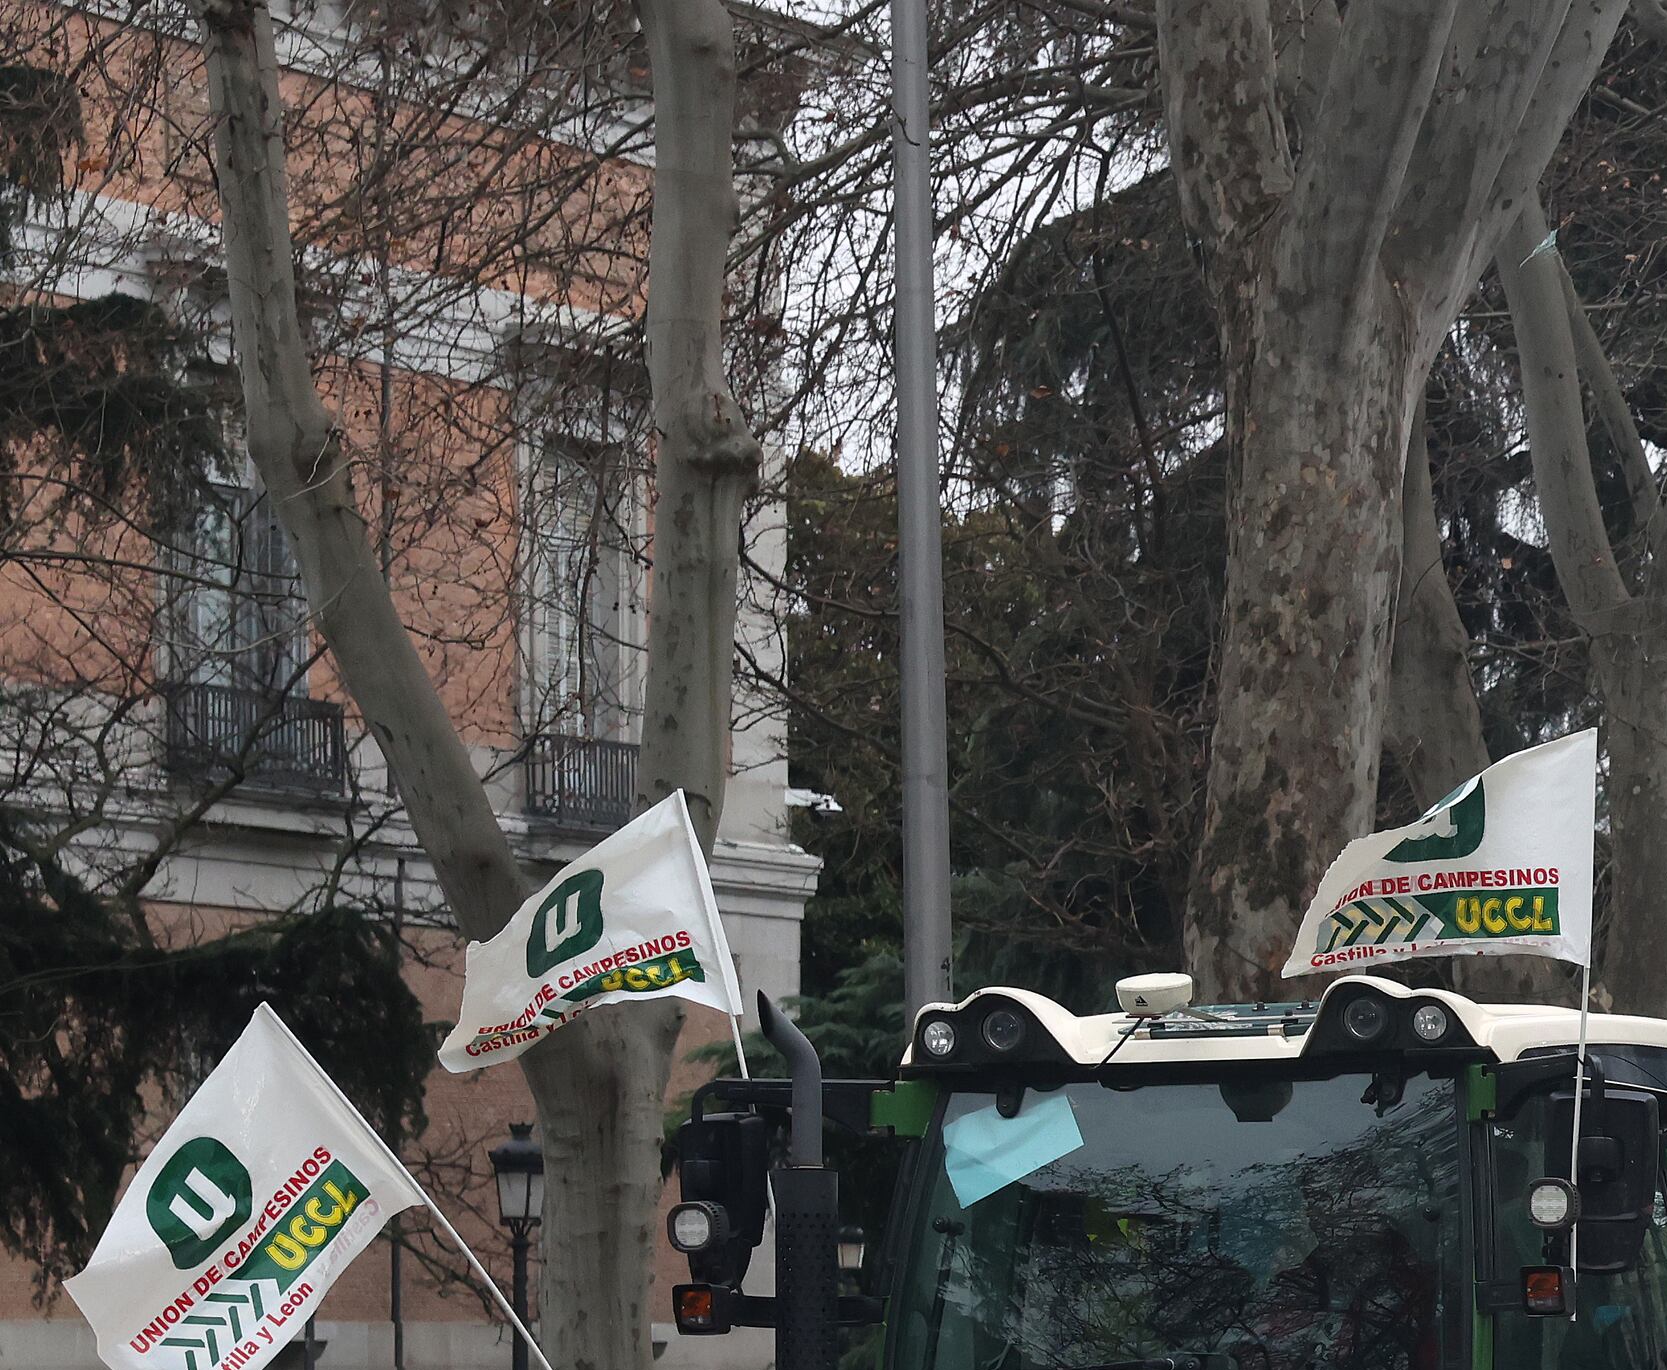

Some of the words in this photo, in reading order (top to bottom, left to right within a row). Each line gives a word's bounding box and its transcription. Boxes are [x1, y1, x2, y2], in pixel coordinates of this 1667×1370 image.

[1381, 875, 1411, 895] DE
[1417, 867, 1560, 892] CAMPESINOS
[1455, 896, 1553, 934] UCCL
[535, 983, 558, 1010] DE
[557, 930, 692, 989] CAMPESINOS
[129, 1292, 194, 1355] UNION
[192, 1265, 224, 1297] DE
[223, 1144, 333, 1269] CAMPESINOS
[264, 1180, 358, 1271] UCCL
[255, 1322, 276, 1345] y
[275, 1281, 315, 1328] León
